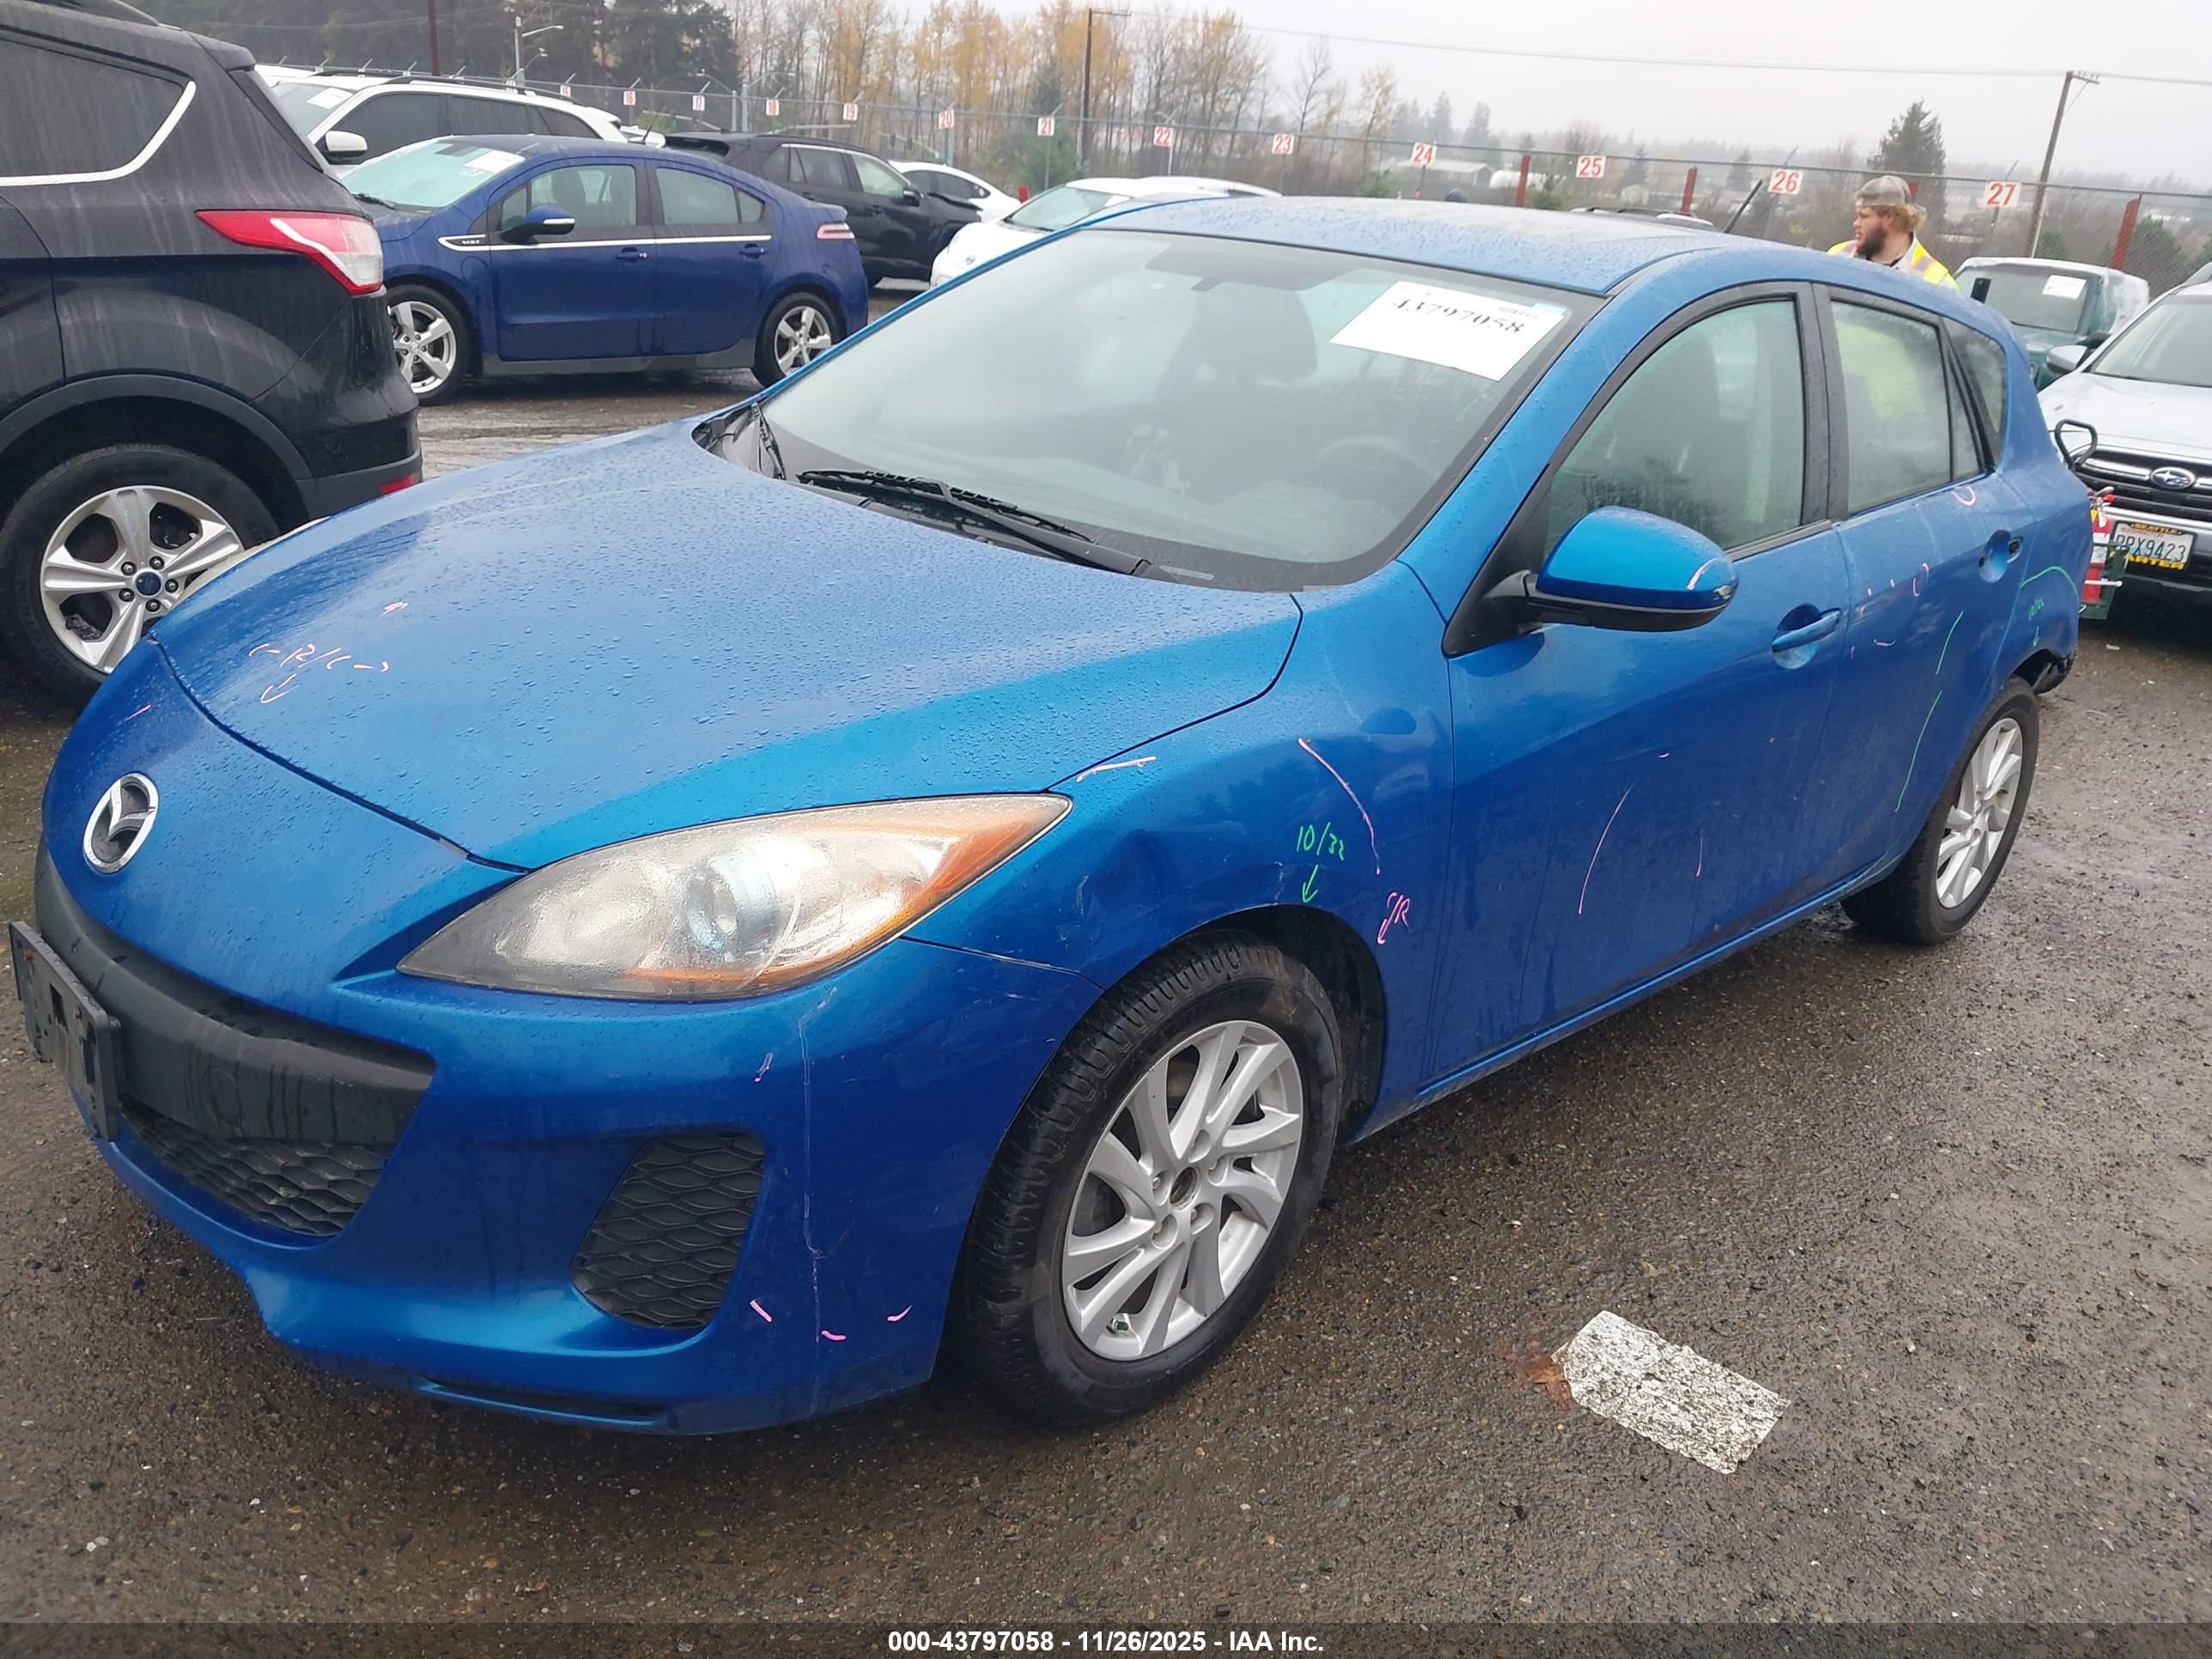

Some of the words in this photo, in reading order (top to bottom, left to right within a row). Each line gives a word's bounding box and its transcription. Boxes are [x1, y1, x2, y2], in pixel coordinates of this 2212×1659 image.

[846, 104, 856, 119] 19
[940, 111, 953, 127] 20
[1041, 118, 1053, 135] 21
[1155, 128, 1171, 145] 22
[1273, 135, 1292, 153] 23
[1413, 145, 1434, 165] 24
[1579, 156, 1602, 177] 25
[1771, 171, 1798, 192] 26
[1985, 181, 2018, 206] 27
[1296, 821, 1345, 861] 10/32
